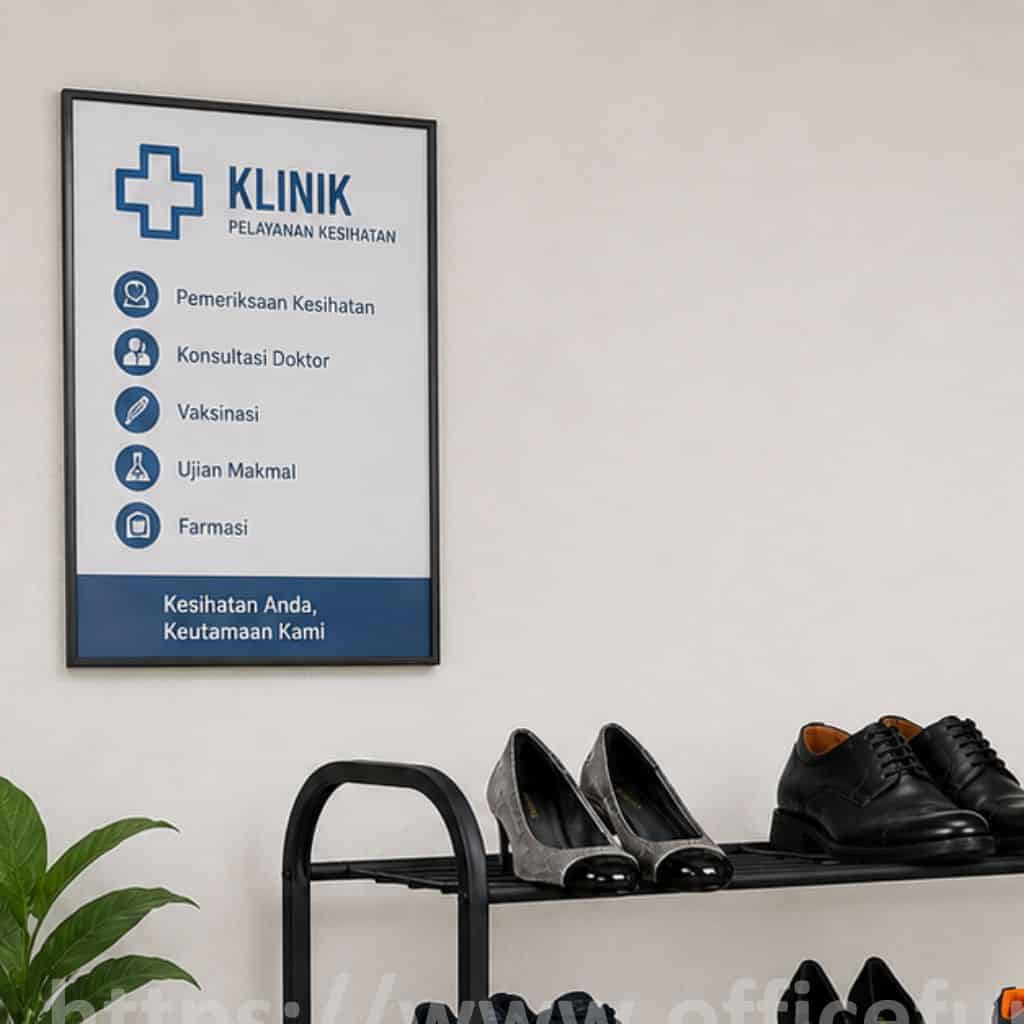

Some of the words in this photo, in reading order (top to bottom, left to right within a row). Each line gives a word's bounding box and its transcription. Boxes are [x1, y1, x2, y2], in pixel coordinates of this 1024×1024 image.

[229, 166, 351, 216] KLINIK
[228, 219, 314, 239] PELAYANAN
[318, 225, 397, 244] KESIHATAN
[176, 288, 288, 311] Pemeriksaan
[292, 295, 375, 316] Kesihatan
[177, 345, 268, 367] Konsultasi
[272, 349, 331, 369] Doktor
[177, 403, 259, 423] Vaksinasi
[177, 460, 223, 482] Ujian
[227, 461, 296, 480] Makmal
[178, 517, 248, 536] Farmasi
[164, 595, 258, 614] Kesihatan
[263, 595, 317, 617] Anda,
[164, 622, 273, 641] Keutamaan
[279, 622, 325, 640] Kami
